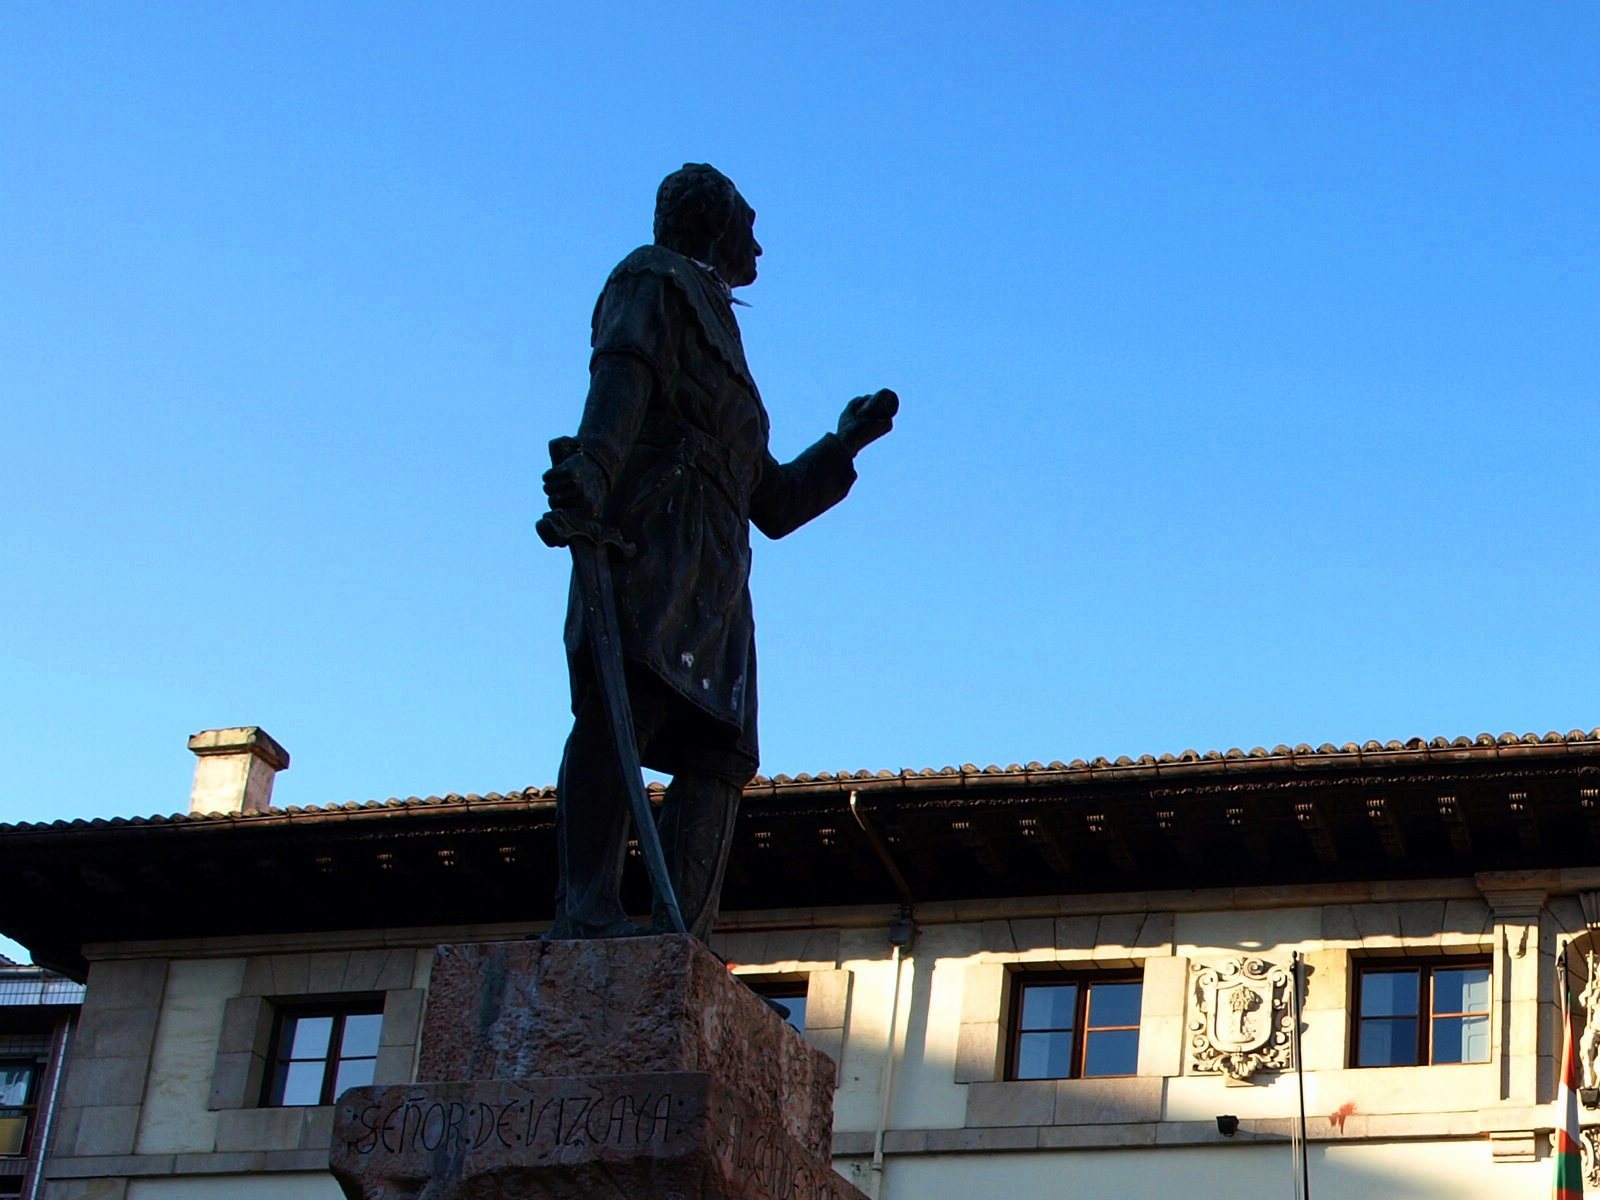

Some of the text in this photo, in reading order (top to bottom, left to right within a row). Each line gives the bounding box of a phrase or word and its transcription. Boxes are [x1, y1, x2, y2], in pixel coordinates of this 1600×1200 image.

[354, 1093, 672, 1154] SEÑOR DE VIZCAYA
